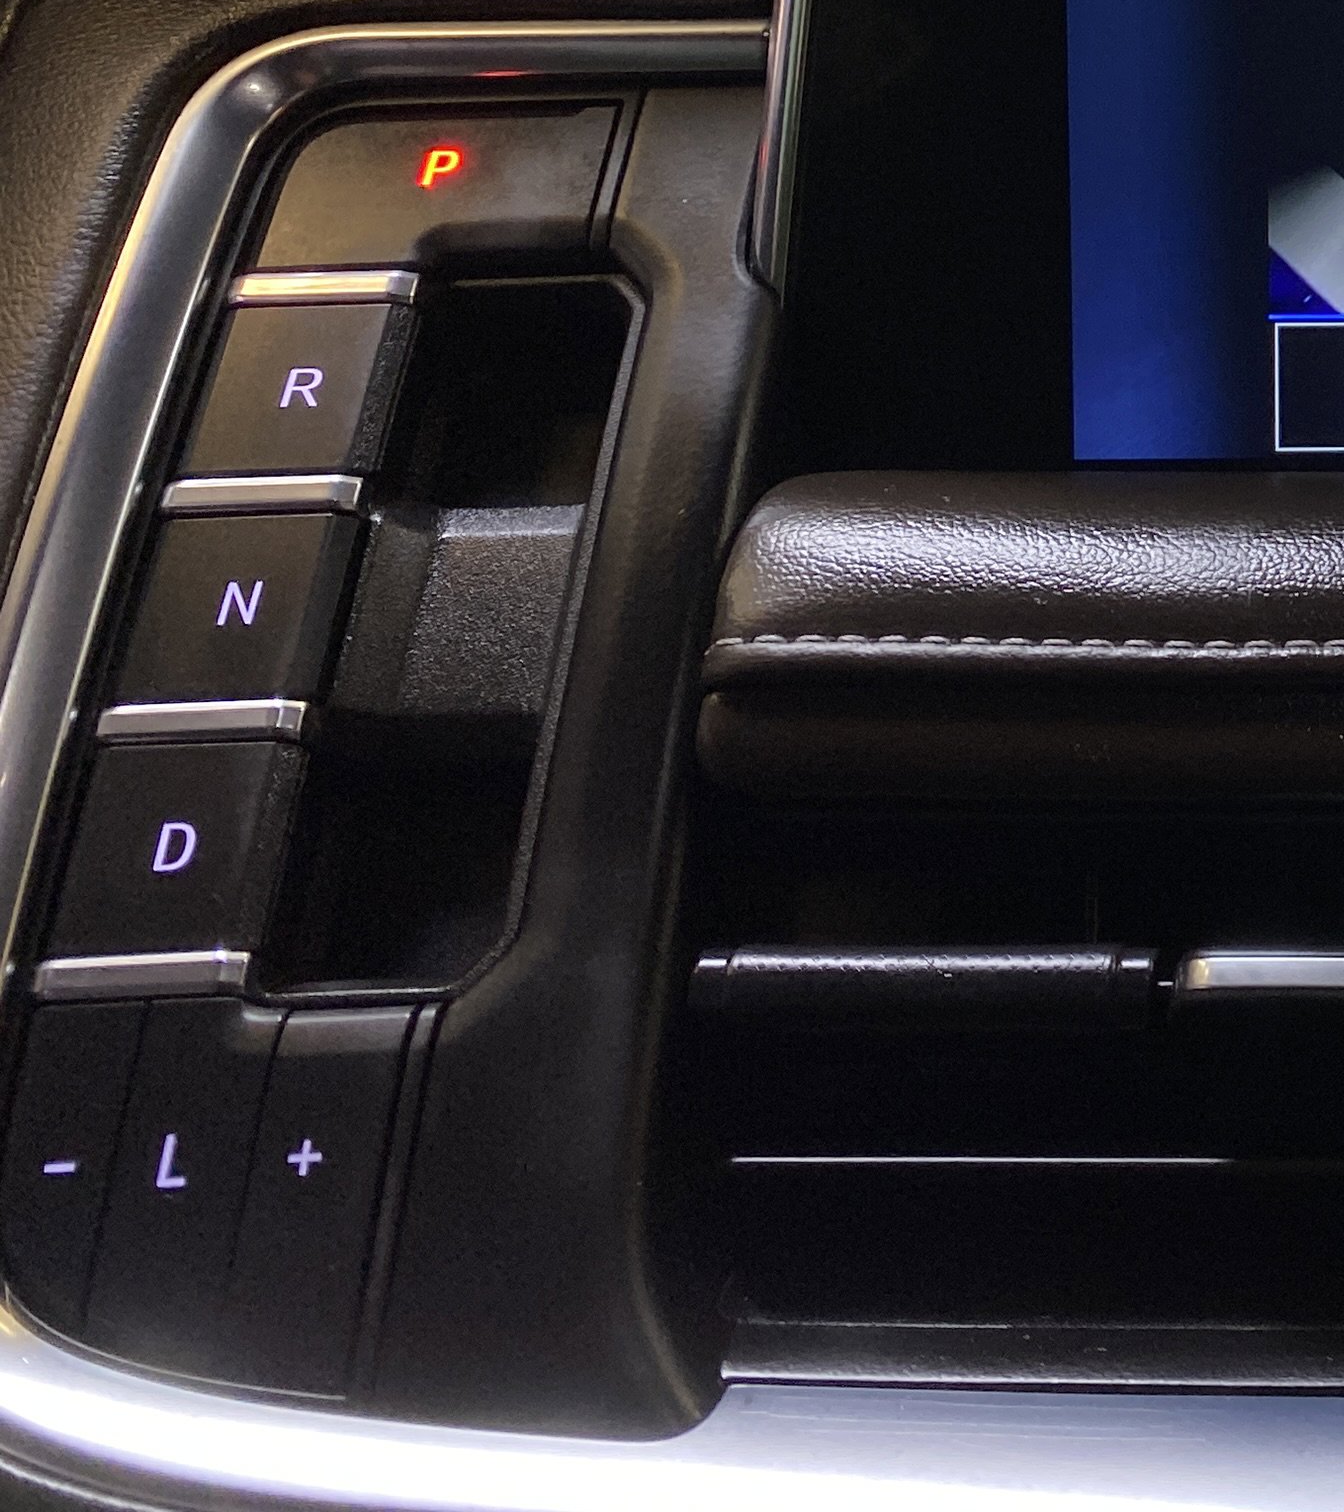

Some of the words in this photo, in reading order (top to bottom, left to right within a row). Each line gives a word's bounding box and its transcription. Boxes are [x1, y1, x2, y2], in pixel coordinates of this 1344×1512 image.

[417, 148, 463, 189] P
[279, 366, 324, 409] R
[215, 579, 264, 627] N
[152, 821, 198, 873] D
[155, 1133, 188, 1189] L
